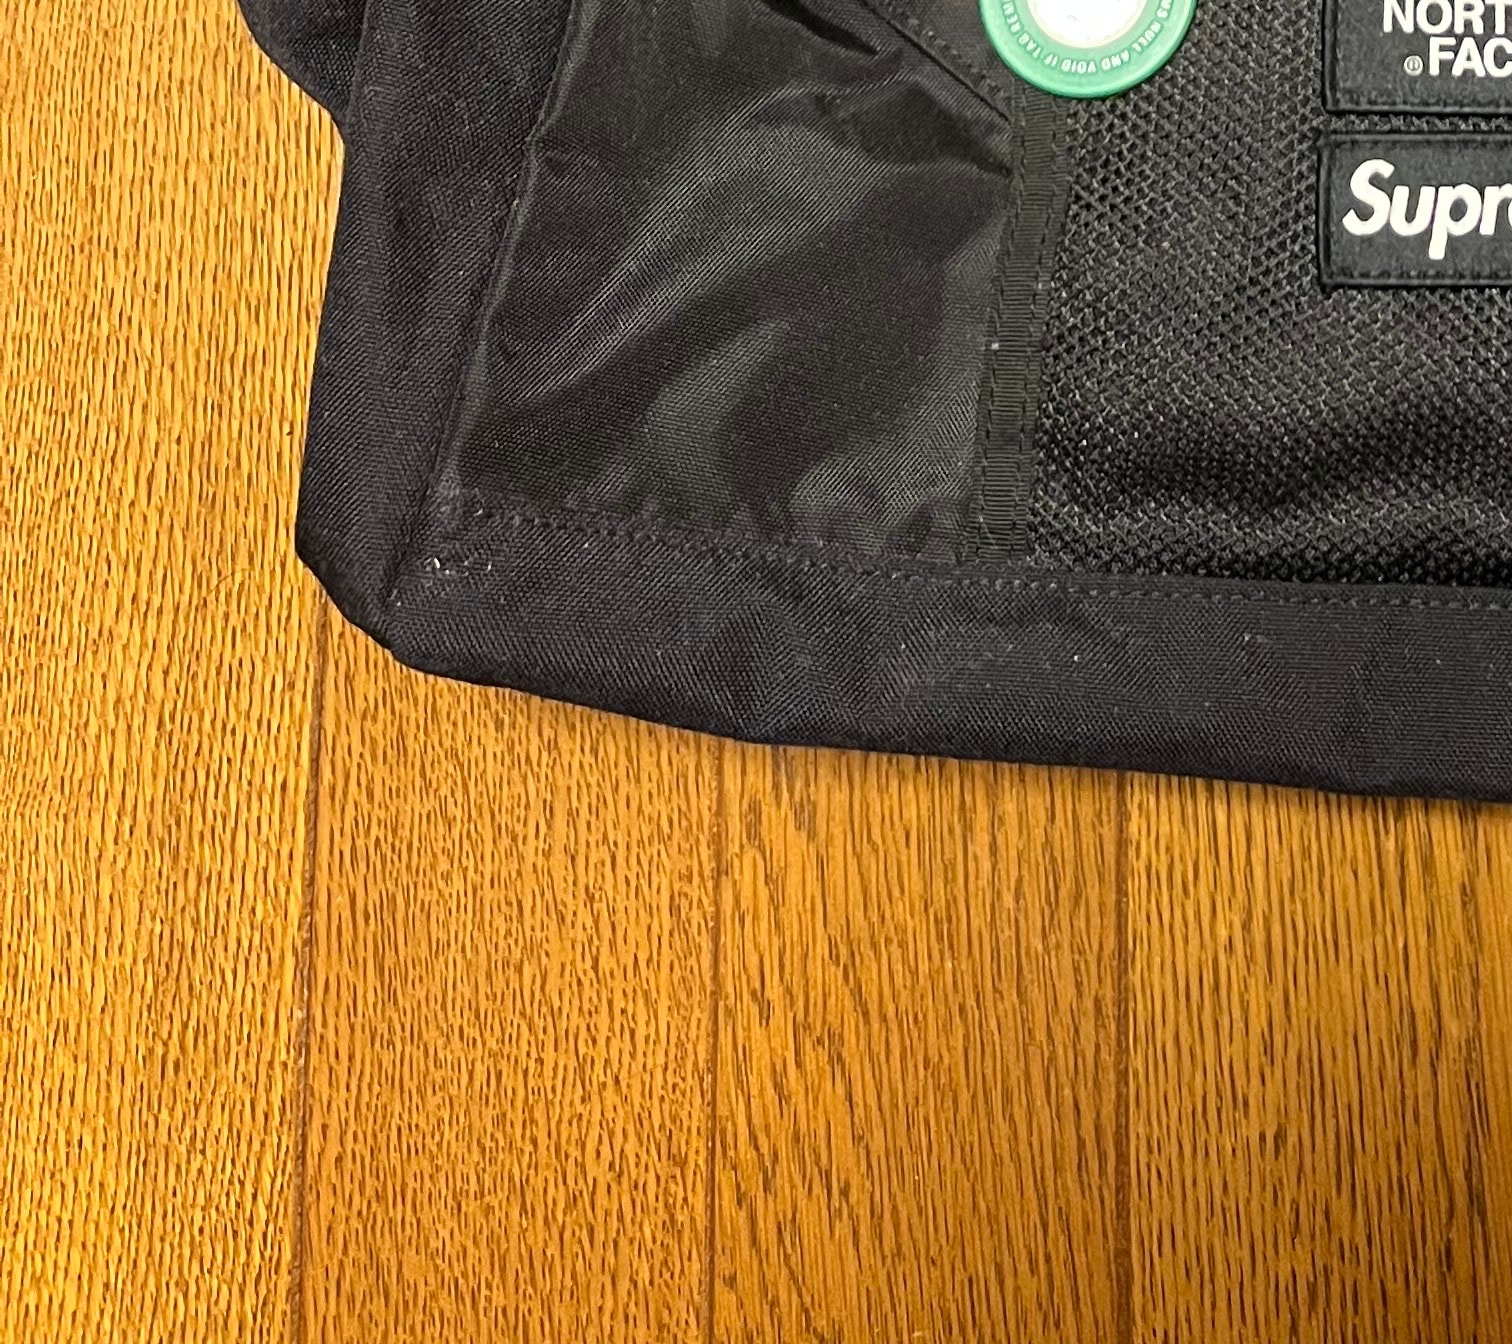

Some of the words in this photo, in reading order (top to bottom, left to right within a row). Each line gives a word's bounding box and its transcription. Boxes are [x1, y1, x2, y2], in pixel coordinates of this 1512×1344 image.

[1018, 30, 1041, 60] TAG
[1133, 22, 1163, 53] NULL
[1043, 51, 1058, 67] IF
[1062, 59, 1097, 74] VOID
[1101, 50, 1131, 69] AND
